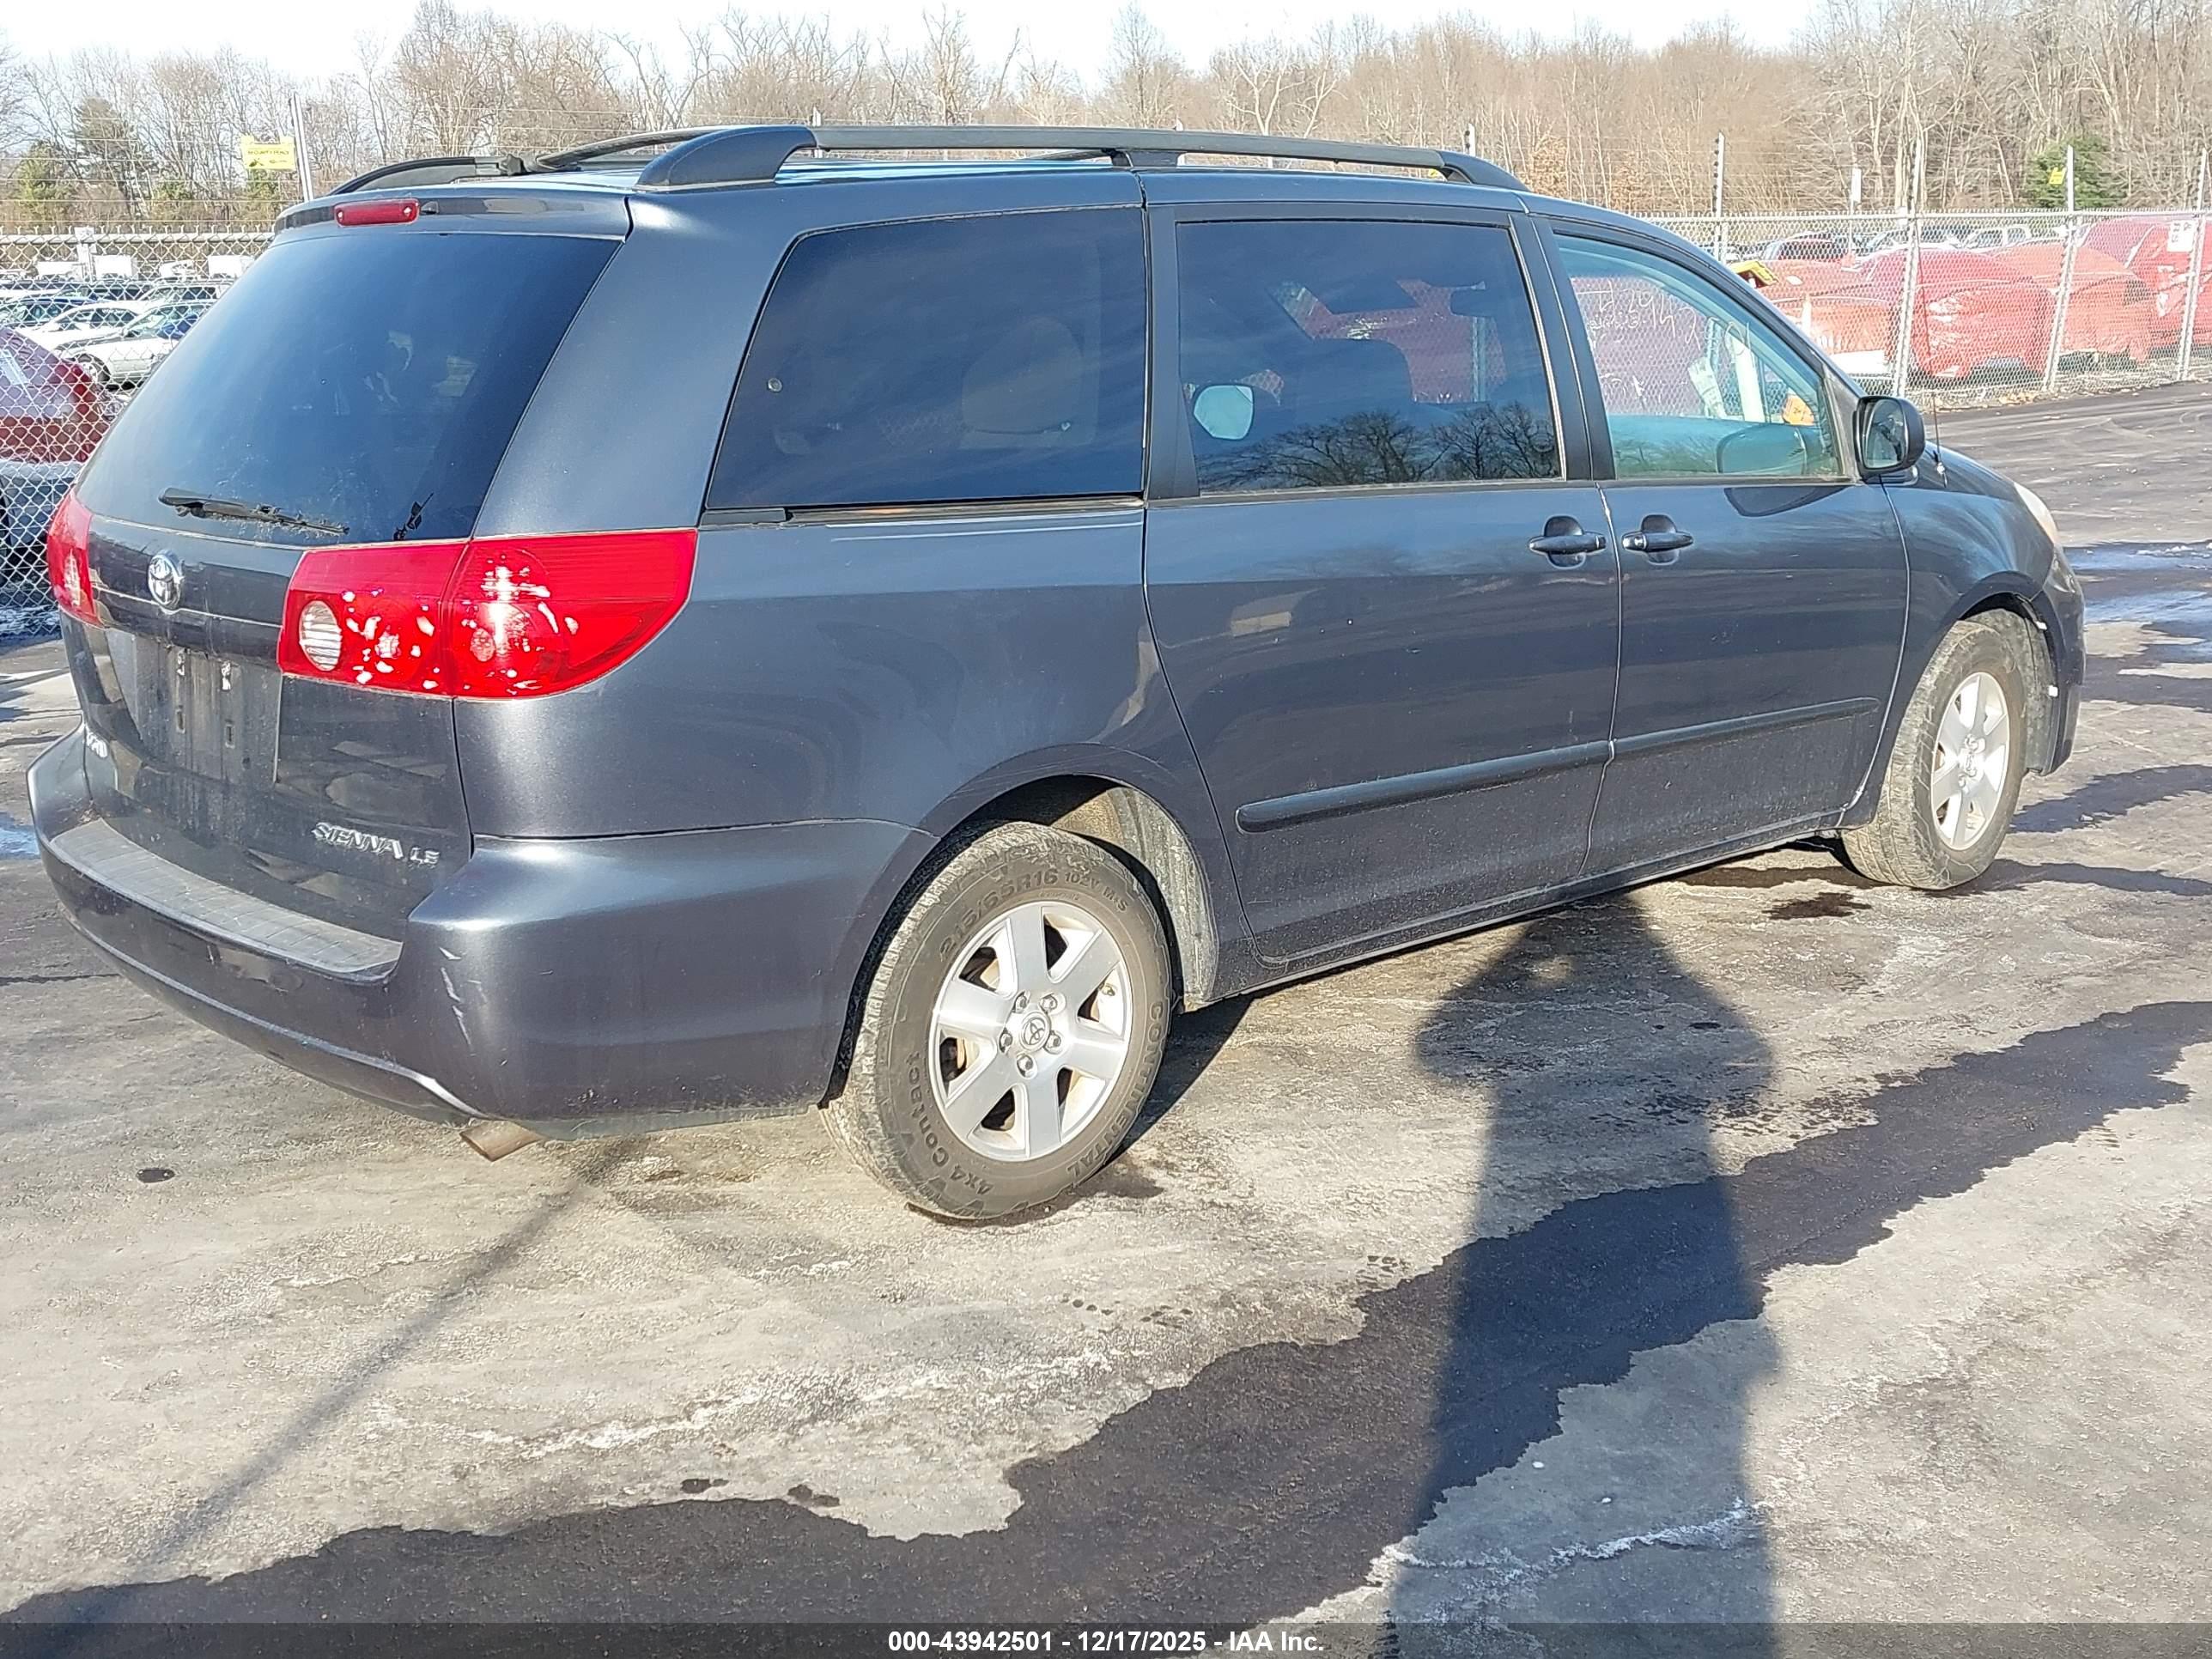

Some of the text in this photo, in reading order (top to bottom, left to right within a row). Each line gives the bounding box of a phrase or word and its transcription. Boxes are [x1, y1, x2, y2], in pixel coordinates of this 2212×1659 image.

[311, 822, 441, 865] SIENNA LE
[939, 868, 1059, 962] 215/65R16
[905, 1051, 950, 1167] Contact
